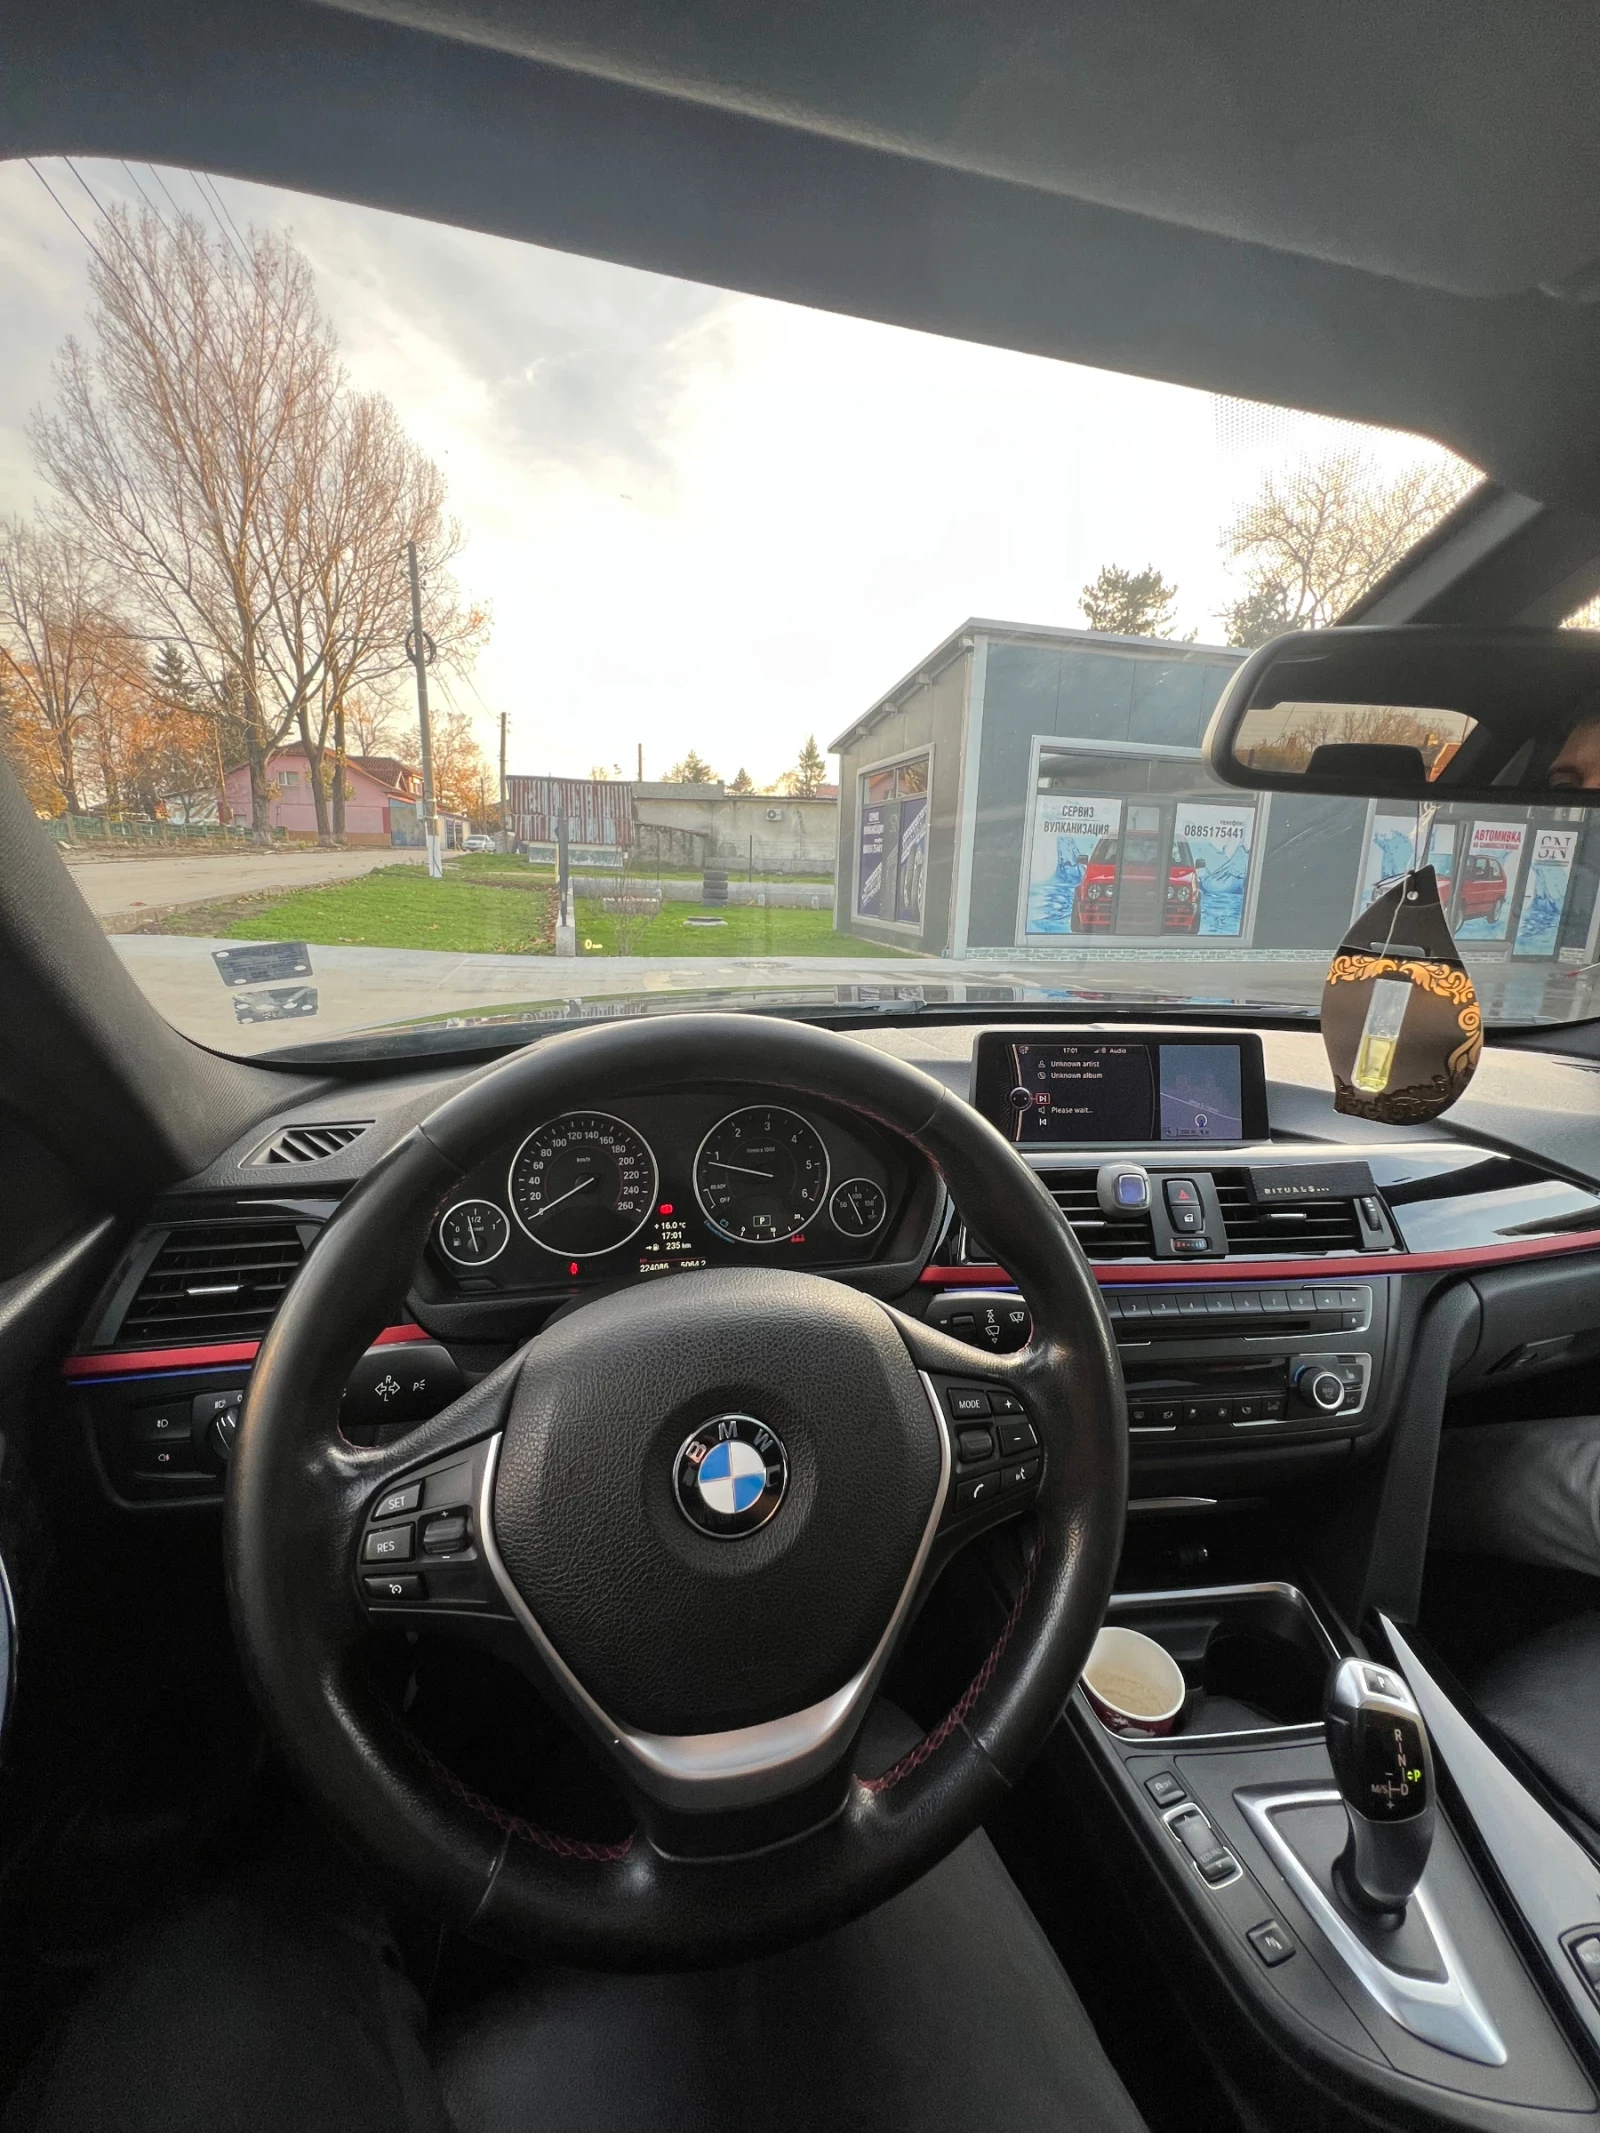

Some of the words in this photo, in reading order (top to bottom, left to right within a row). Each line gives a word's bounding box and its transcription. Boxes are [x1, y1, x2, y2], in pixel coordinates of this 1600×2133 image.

[1062, 805, 1094, 818] СЕРВИЗ
[1043, 821, 1110, 836] ВУЛКАНИЗАЦИЯ
[1184, 825, 1244, 838] 0885175441
[1473, 829, 1522, 843] АВТОМИВКА
[1051, 1106, 1074, 1114] Please
[764, 1121, 771, 1131] 3
[567, 1132, 582, 1140] 120
[584, 1131, 599, 1139] 140
[735, 1128, 741, 1138] 2
[552, 1138, 567, 1147] 100
[600, 1136, 614, 1145] 160
[791, 1134, 797, 1143] 4
[540, 1148, 552, 1157] 80
[612, 1145, 626, 1153] 180
[715, 1151, 719, 1160] 1
[533, 1161, 544, 1170] 60
[618, 1157, 635, 1166] 200
[806, 1160, 812, 1169] 5
[623, 1171, 640, 1179] 220
[529, 1176, 540, 1185] 40
[623, 1186, 640, 1195] 240
[801, 1188, 808, 1198] 6
[530, 1192, 541, 1201] 20
[617, 1202, 634, 1211] 260
[760, 1217, 766, 1225] P
[455, 1225, 460, 1233] 0
[662, 1231, 682, 1240] 17:01
[666, 1242, 681, 1250] 235
[385, 1374, 392, 1384] R
[383, 1393, 389, 1402] L
[958, 1400, 980, 1409] MODE
[685, 1420, 774, 1464] BMW
[388, 1495, 406, 1510] SET
[376, 1540, 395, 1554] RES
[1394, 1729, 1402, 1742] R
[1398, 1754, 1406, 1767] N
[1413, 1769, 1421, 1782] P
[1371, 1783, 1388, 1794] M/S
[1400, 1783, 1409, 1796] D
